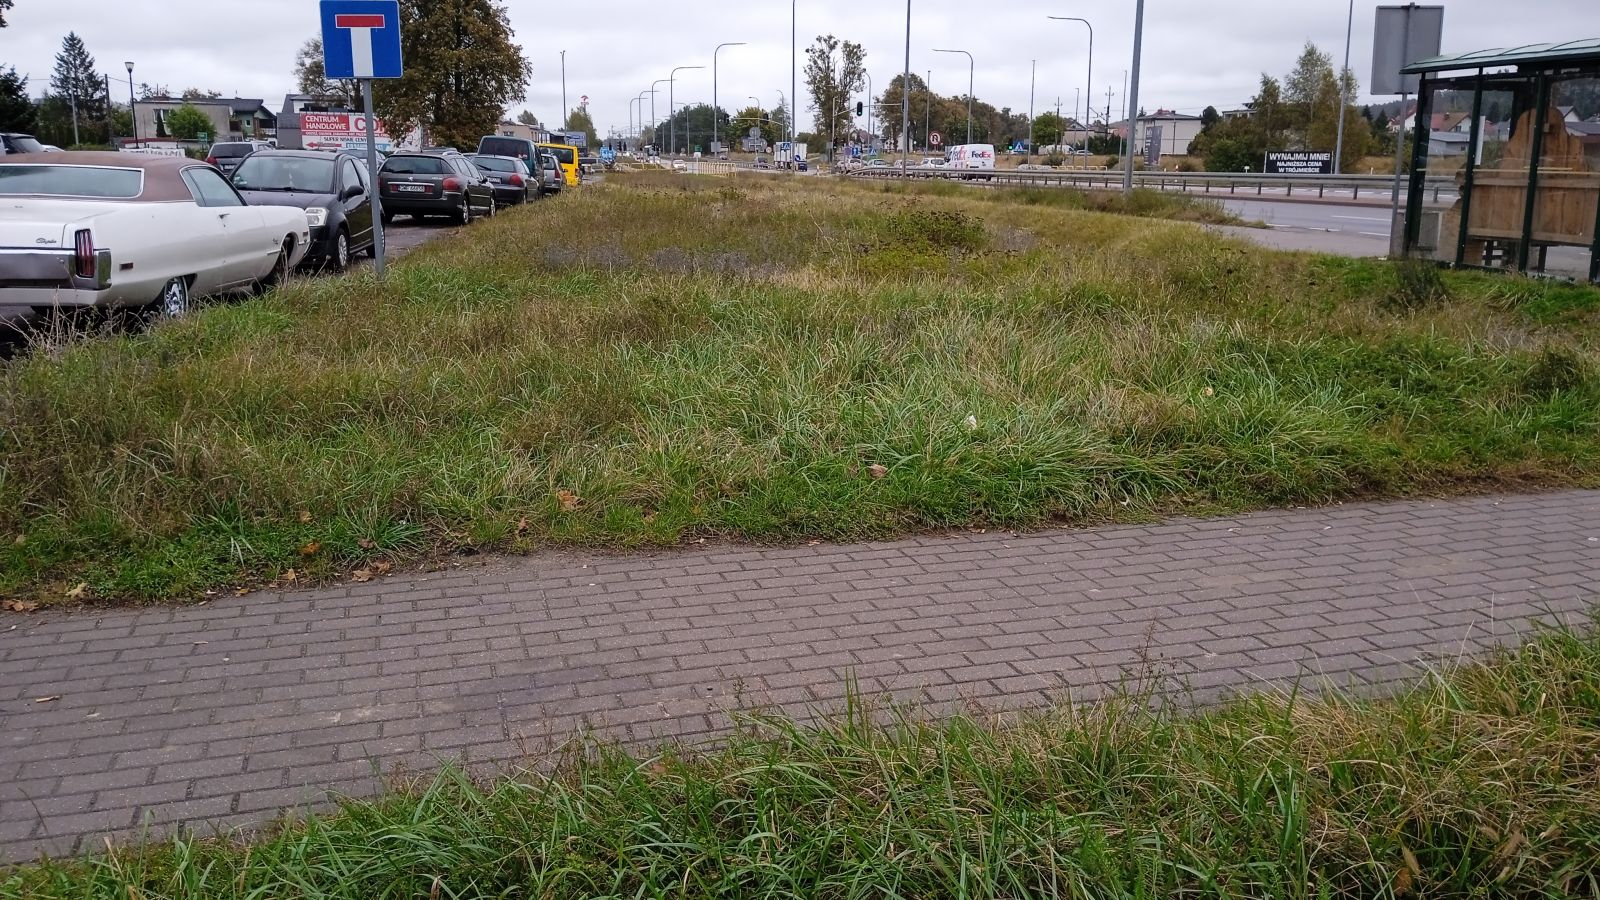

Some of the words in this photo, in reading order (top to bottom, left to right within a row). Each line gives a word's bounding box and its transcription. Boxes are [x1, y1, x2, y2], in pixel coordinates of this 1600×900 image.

[305, 115, 339, 123] CENTRUM
[305, 122, 347, 130] HANDLOWE
[971, 150, 992, 159] FedEx
[1269, 152, 1308, 161] WYNAJMIJ
